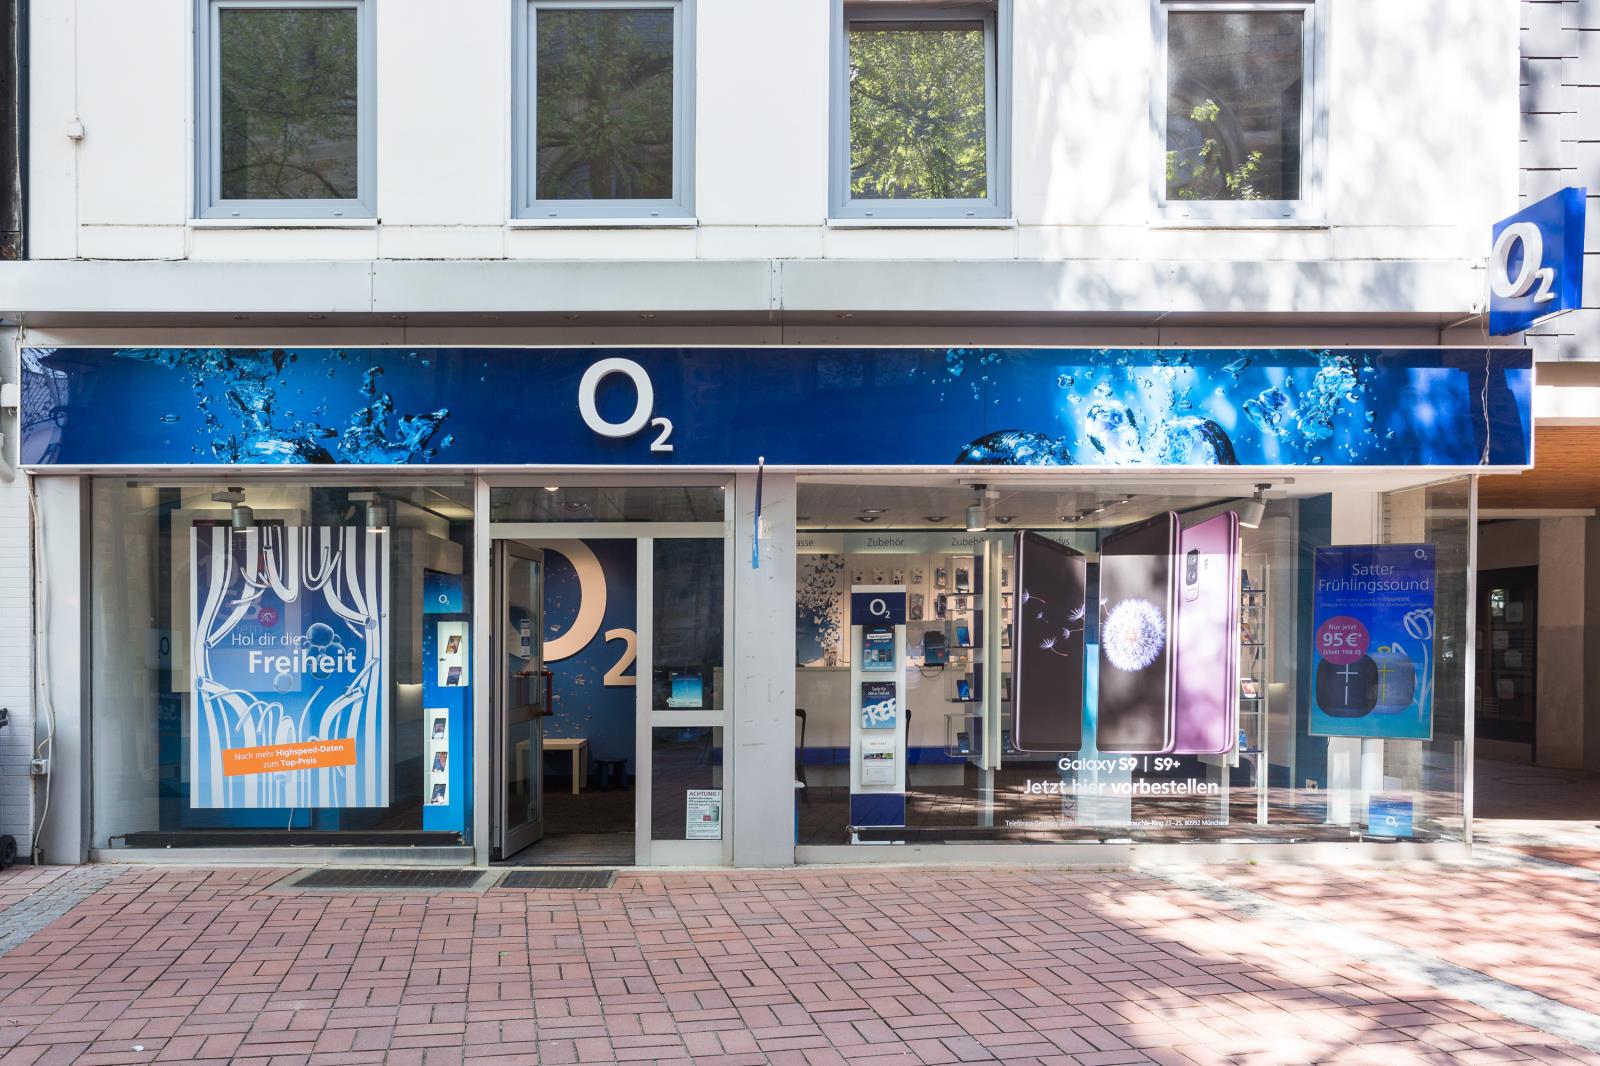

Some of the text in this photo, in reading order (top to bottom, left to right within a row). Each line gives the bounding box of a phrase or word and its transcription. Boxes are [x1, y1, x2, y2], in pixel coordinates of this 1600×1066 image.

[1491, 221, 1555, 303] O2
[578, 357, 674, 452] O2
[795, 539, 815, 547] asse
[867, 537, 904, 546] Zubehör
[1352, 563, 1395, 576] Satter
[1318, 578, 1429, 594] Frühlingssound
[869, 598, 891, 619] O2
[231, 633, 300, 646] Hol dir die
[248, 650, 357, 674] Freiheit
[234, 744, 345, 761] Noch mehr Highspeed-Daten
[280, 756, 318, 768] Top-Preis
[1058, 757, 1115, 774] Galaxy
[1119, 757, 1138, 771] S9
[1153, 757, 1181, 772] S9+
[1023, 778, 1219, 796] Jetzt hier vorbestellen
